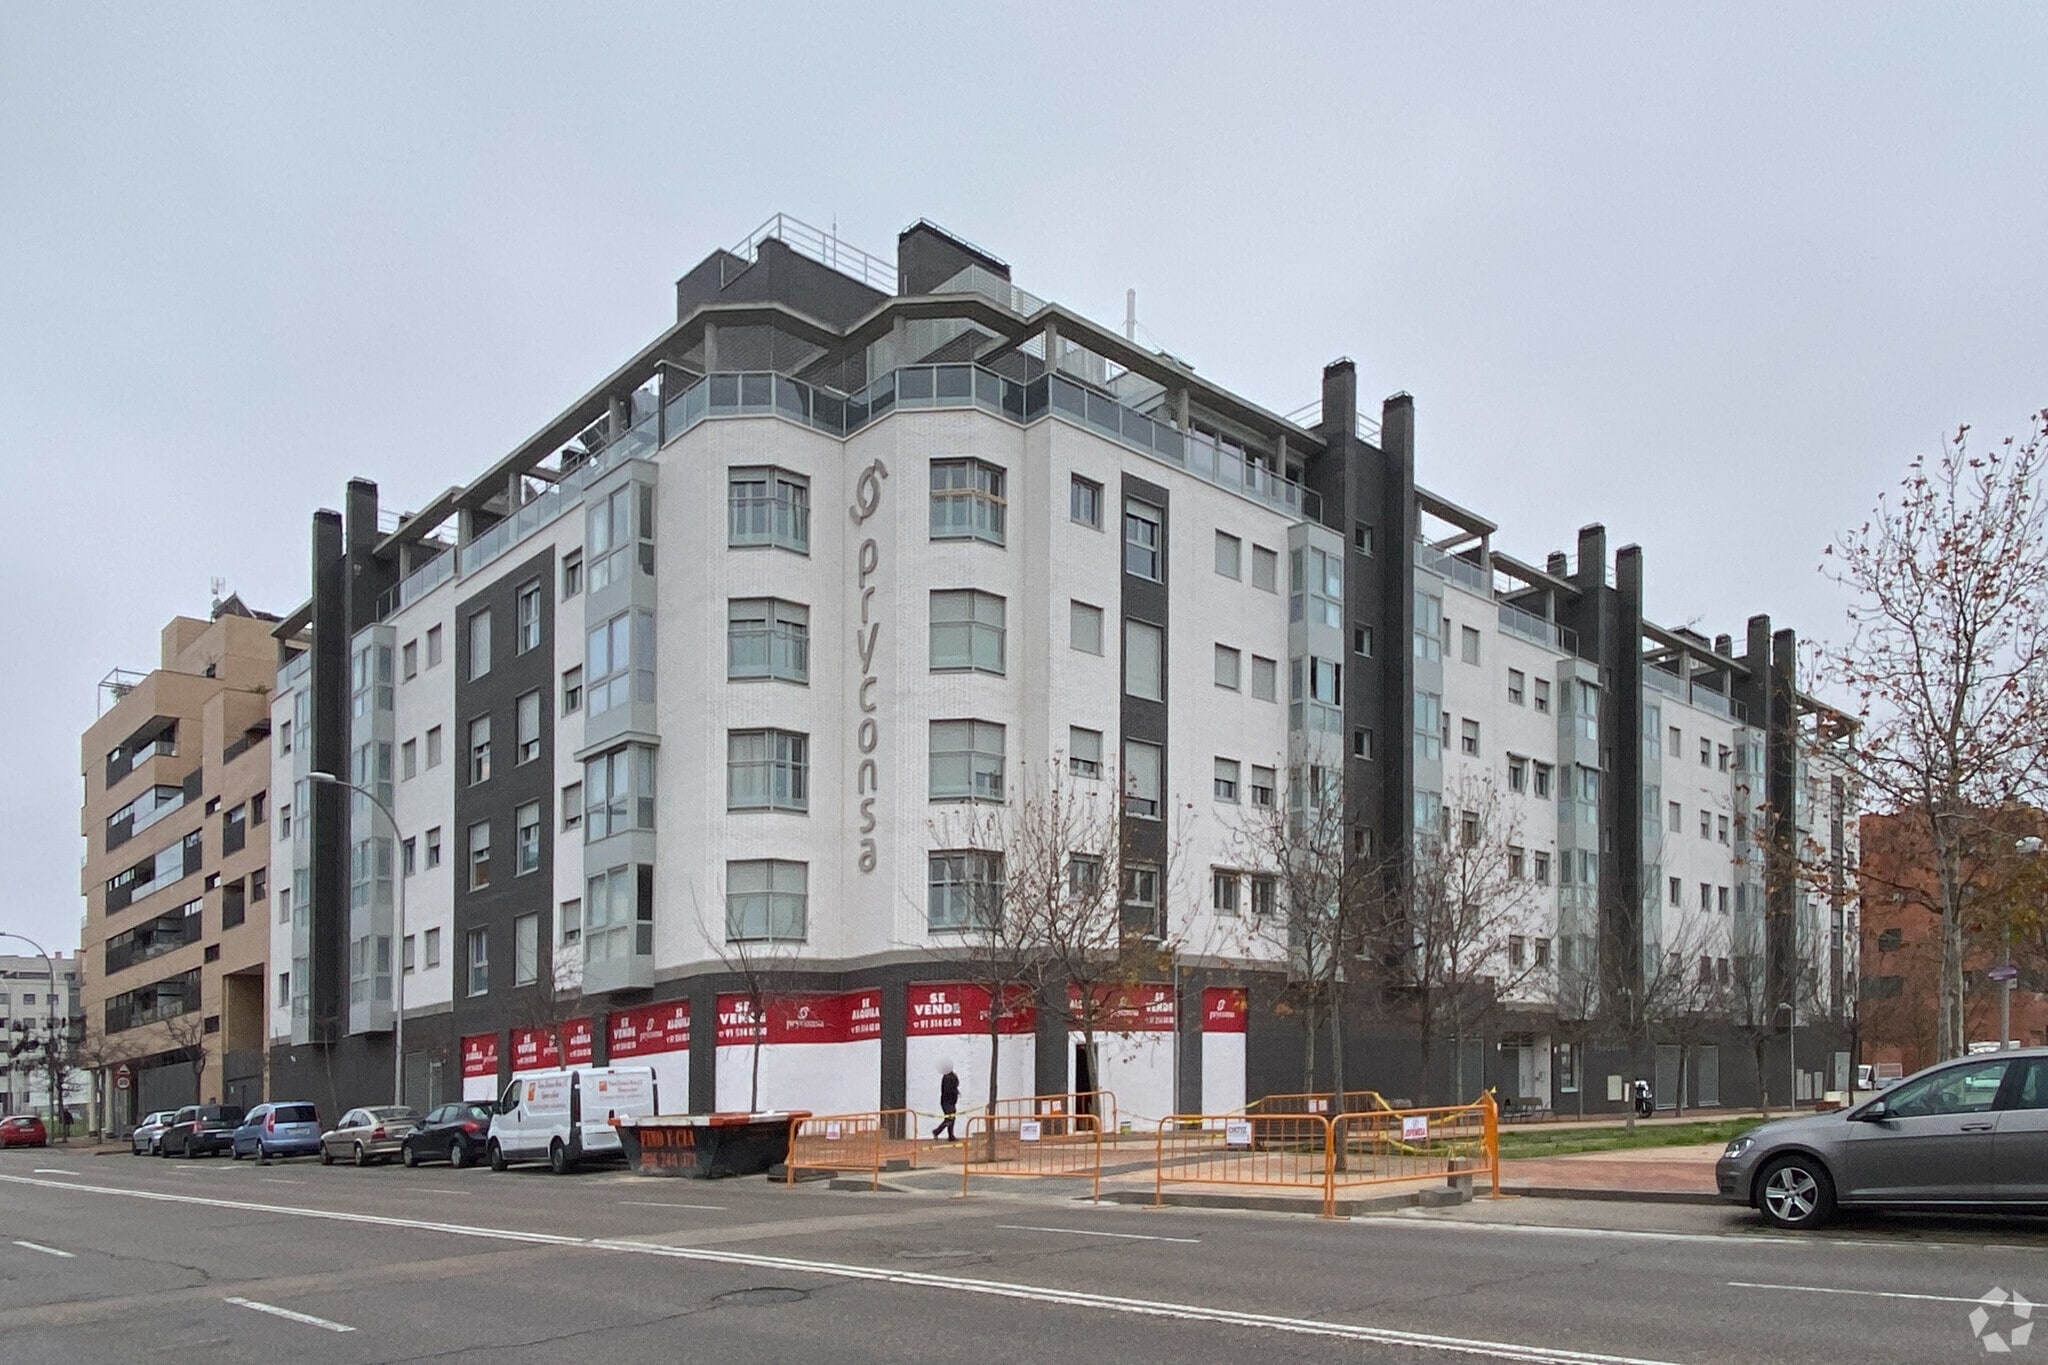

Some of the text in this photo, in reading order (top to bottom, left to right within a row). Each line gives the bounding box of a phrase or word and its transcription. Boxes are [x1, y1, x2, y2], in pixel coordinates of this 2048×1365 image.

[857, 538, 880, 873] pryconsa
[929, 992, 946, 1004] SE
[852, 1007, 880, 1020] ALQUILA
[914, 1003, 961, 1016] VENDE
